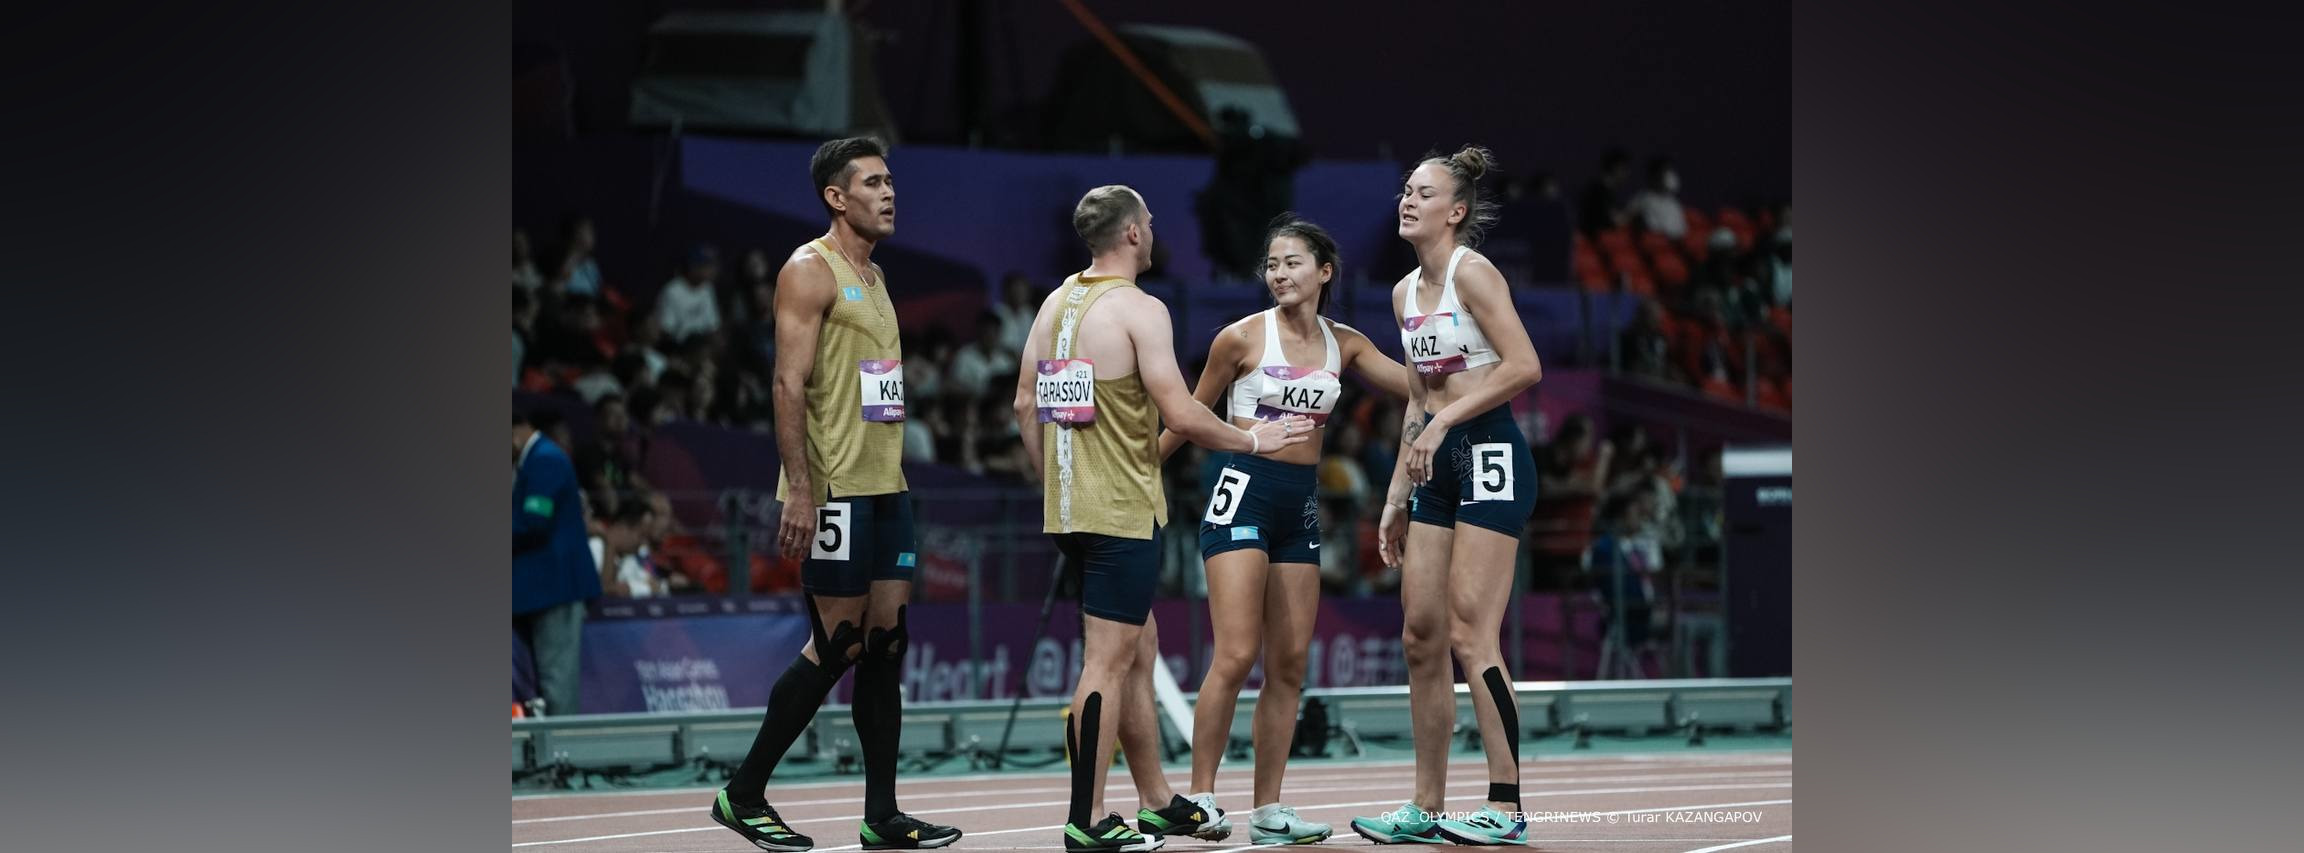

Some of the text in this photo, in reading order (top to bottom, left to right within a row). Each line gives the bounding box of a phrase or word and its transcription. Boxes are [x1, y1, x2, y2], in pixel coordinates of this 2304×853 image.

[1410, 335, 1441, 358] KAZ
[1281, 385, 1325, 410] KAZ
[1481, 450, 1506, 493] 5
[1212, 475, 1240, 517] 5
[818, 509, 842, 553] 5
